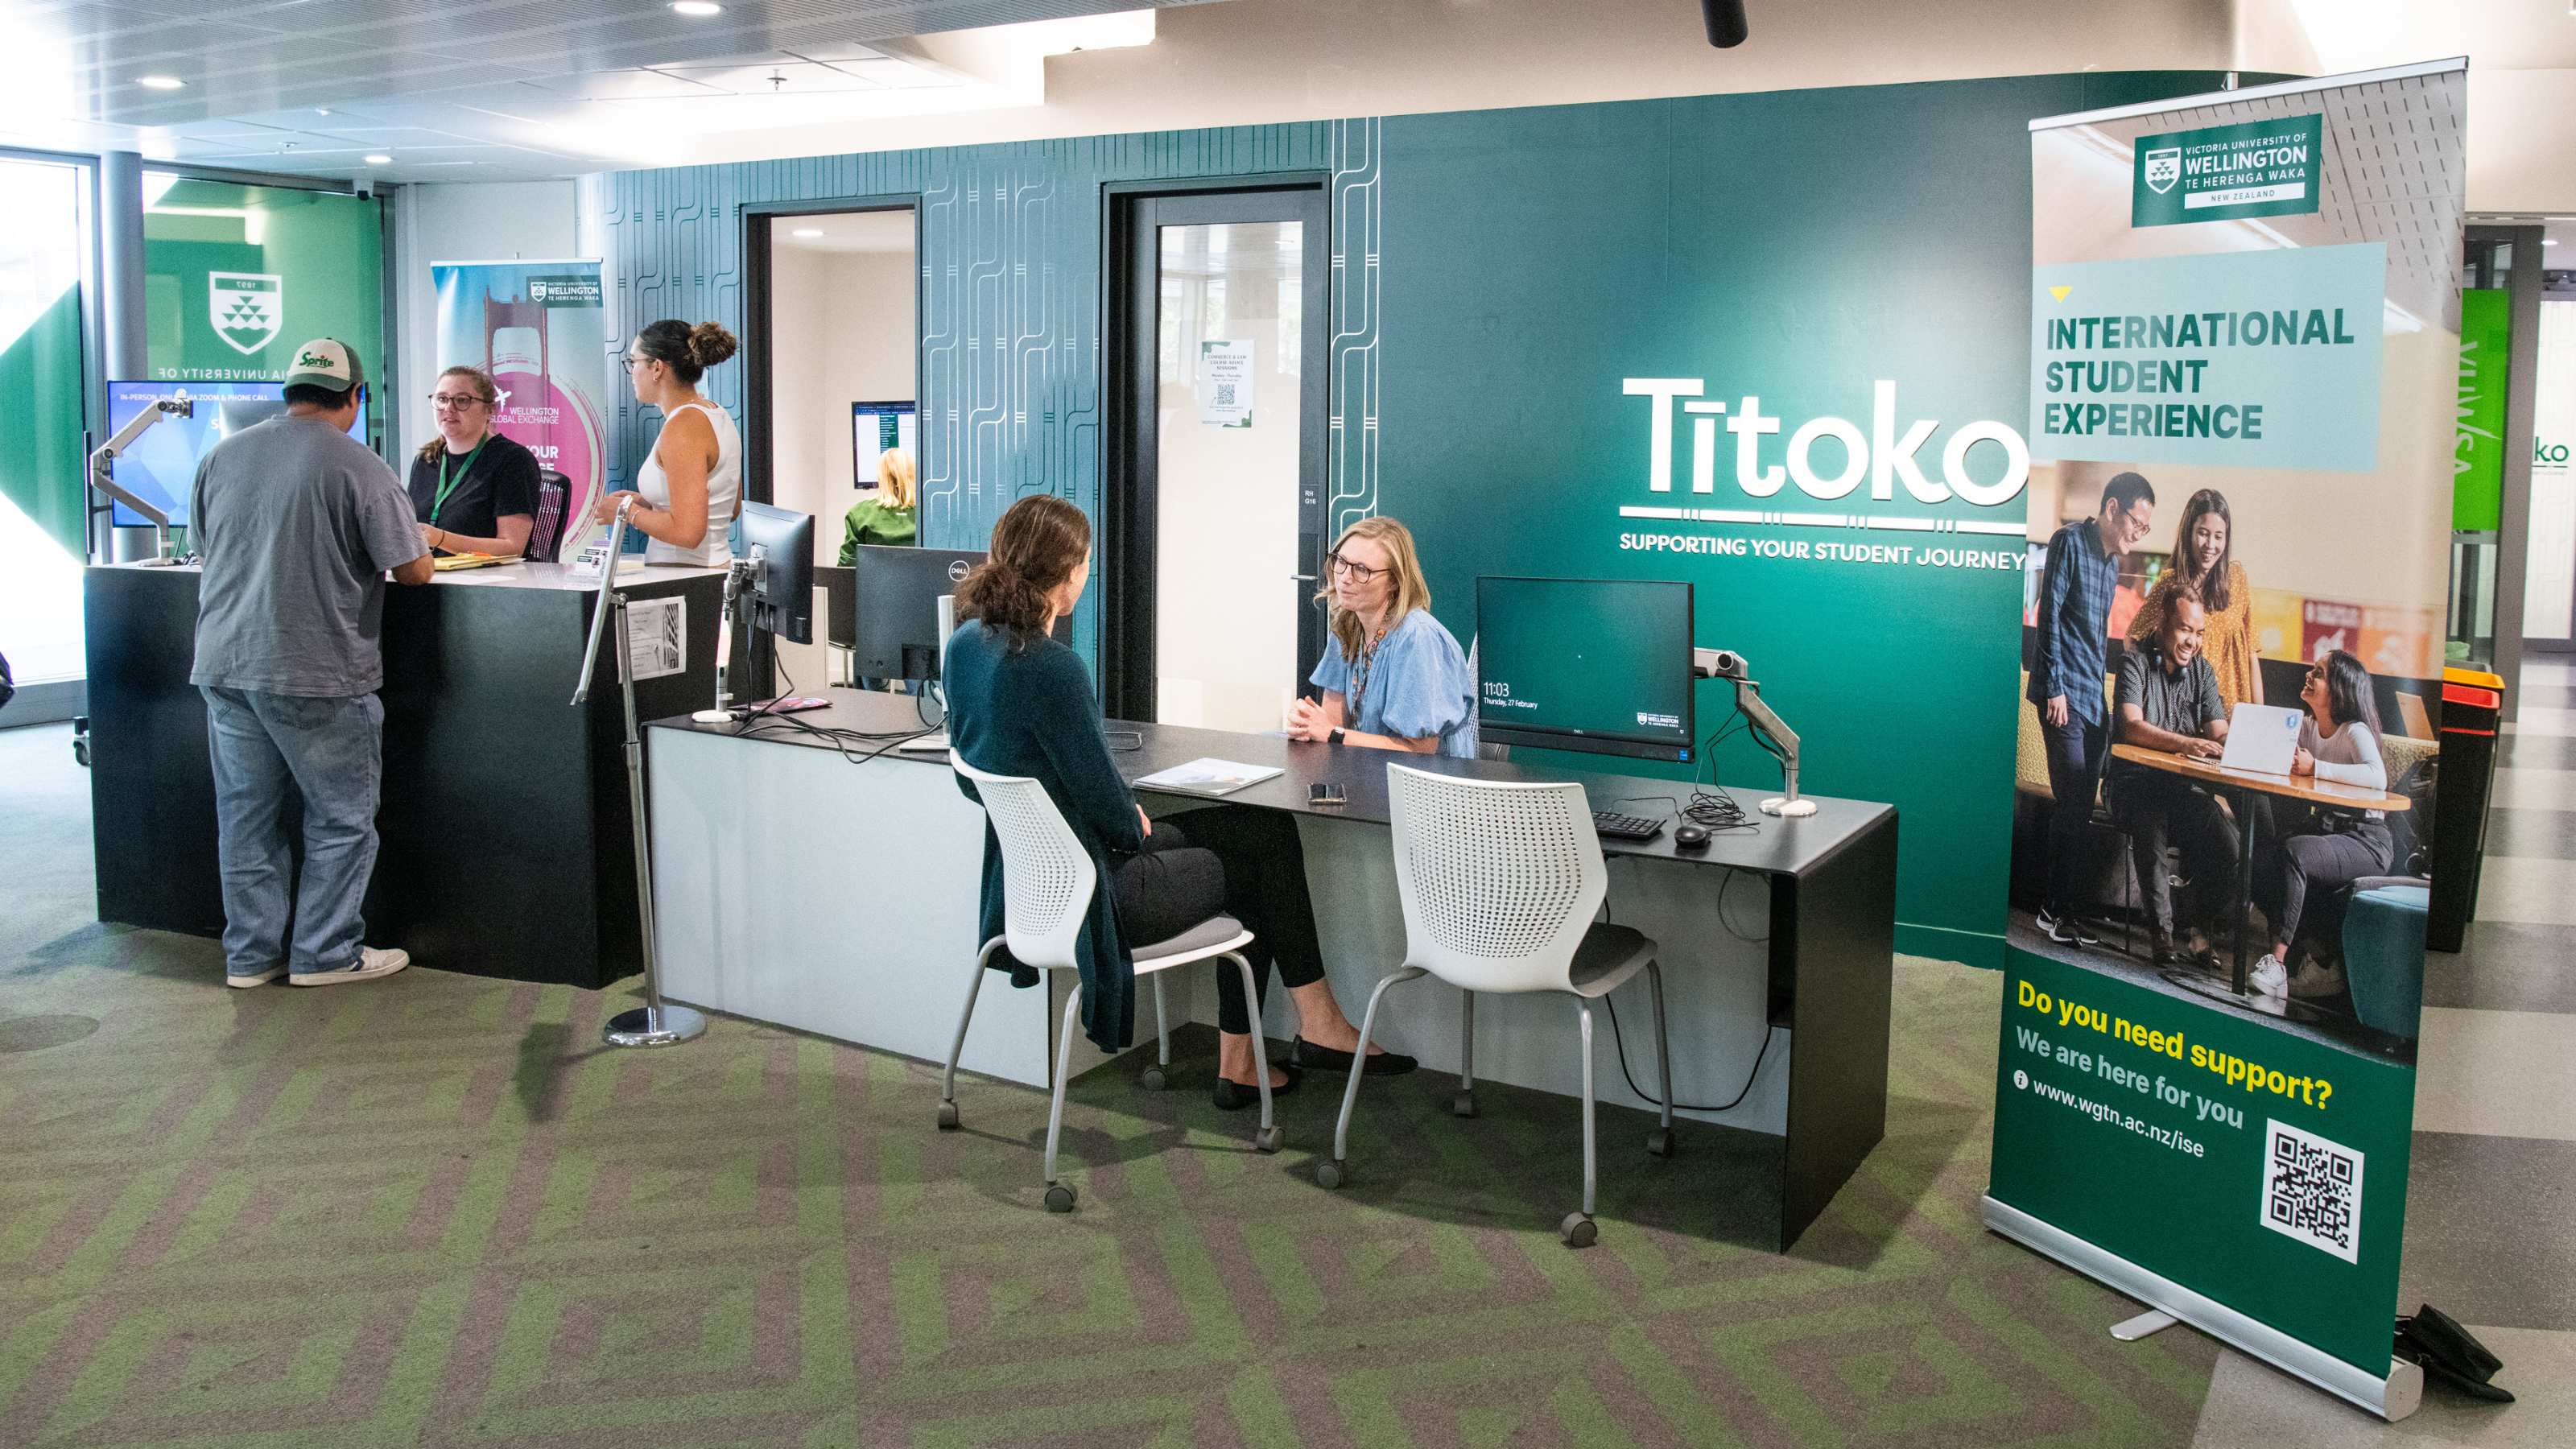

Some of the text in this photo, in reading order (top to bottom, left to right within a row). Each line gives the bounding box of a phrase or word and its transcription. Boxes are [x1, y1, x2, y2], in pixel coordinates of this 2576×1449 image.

[2186, 133, 2307, 155] VICTORIA UNIVERSITY OF
[2185, 145, 2308, 175] WELLINGTON
[2185, 167, 2306, 189] TE HERENGA WAKA
[2211, 189, 2275, 202] NEW ZEALAND
[548, 287, 599, 295] WELLINGTON
[2046, 308, 2355, 350] INTERNATIONAL
[299, 351, 335, 369] Sprite
[2046, 360, 2209, 393] STUDENT
[510, 407, 559, 416] WELLINGTON
[518, 415, 559, 424] EXCHANGE
[2044, 403, 2263, 440] EXPERIENCE
[1622, 378, 2029, 507] Tītoko
[1620, 532, 2027, 571] SUPPORTING YOUR STUDENT JOURNEY
[1484, 682, 1509, 697] 11:03
[1484, 697, 1538, 710] Thursday, 27 February
[1648, 716, 1679, 724] WELLINGTON
[2018, 980, 2333, 1110] Do you need support?
[2016, 1026, 2244, 1129] We are here for you
[2033, 1079, 2205, 1158] www.wgtn.ac.nz/ise
